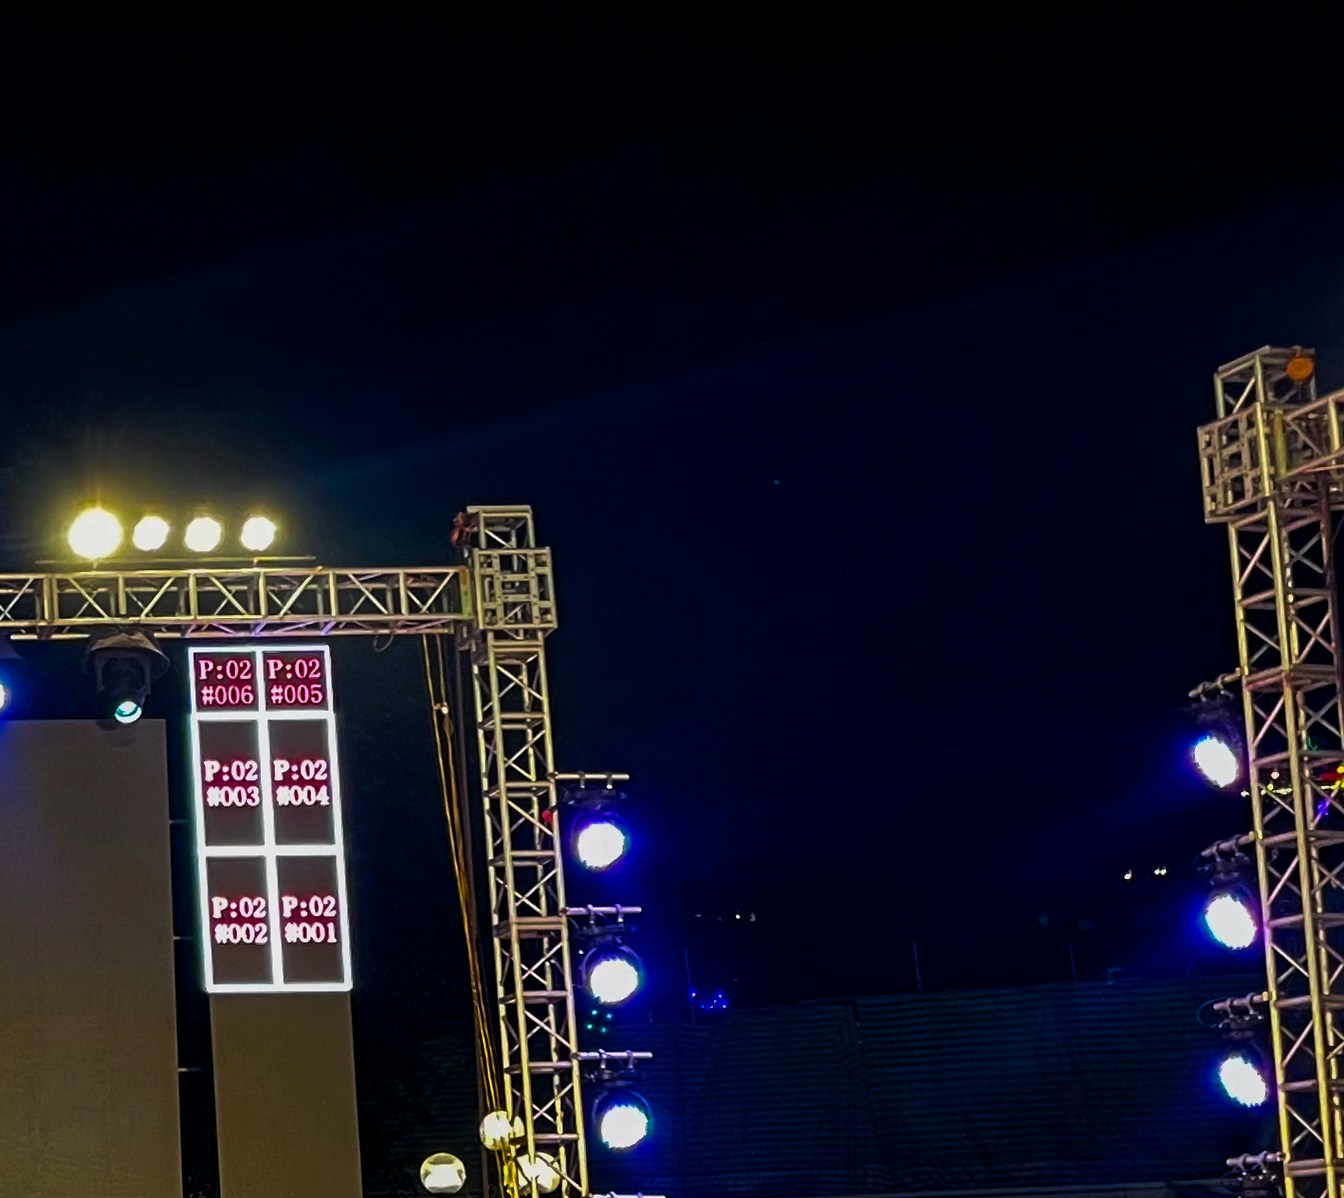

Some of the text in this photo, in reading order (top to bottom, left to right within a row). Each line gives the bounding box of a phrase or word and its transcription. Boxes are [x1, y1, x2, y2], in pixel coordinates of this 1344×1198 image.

[198, 659, 252, 680] P:02
[267, 659, 322, 680] P:02
[201, 685, 255, 705] #006
[270, 684, 324, 704] #005
[203, 760, 259, 782] P:02
[273, 759, 328, 781] P:02
[206, 786, 260, 807] #003
[276, 785, 330, 807] #004
[211, 896, 267, 918] P:02
[281, 895, 337, 918] P:02
[214, 922, 268, 944] #002
[284, 922, 338, 944] #001
